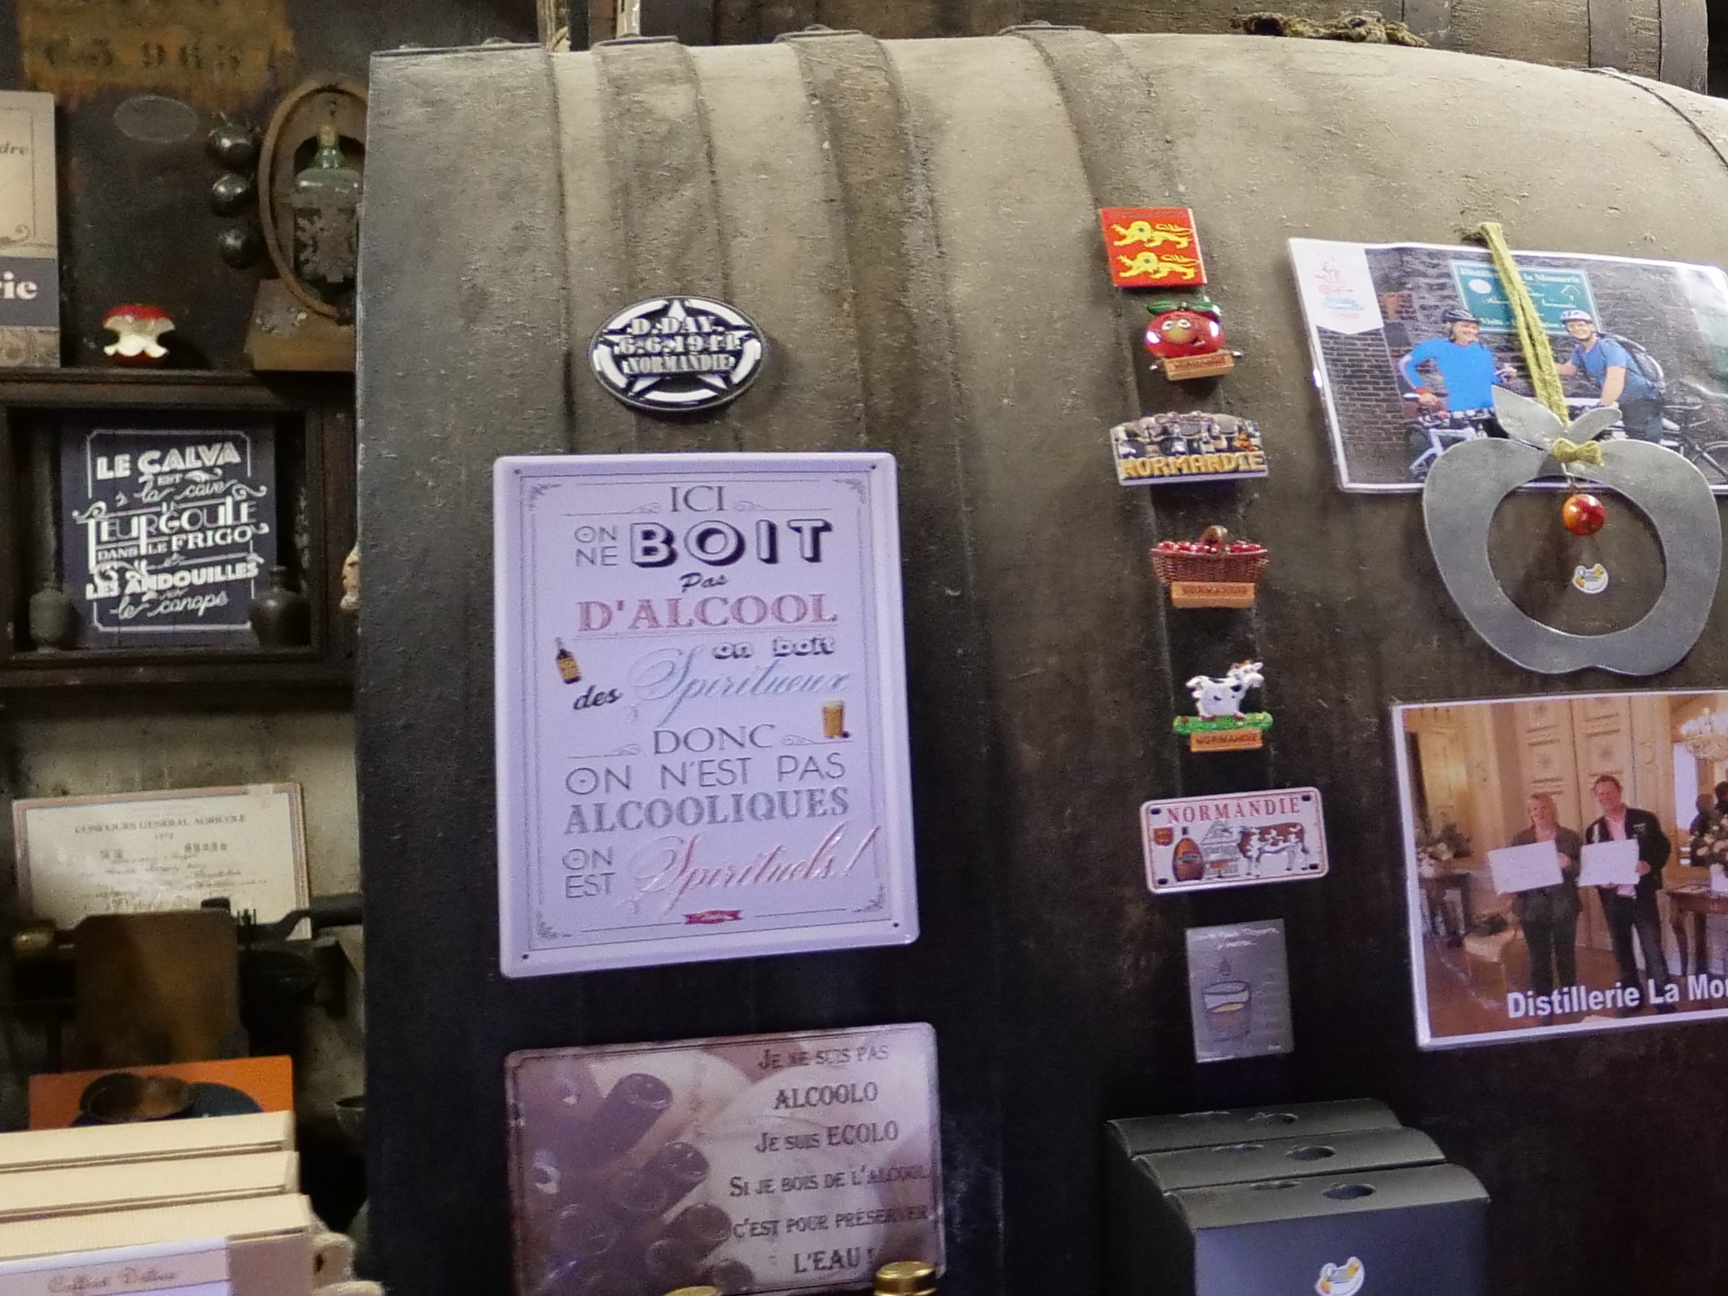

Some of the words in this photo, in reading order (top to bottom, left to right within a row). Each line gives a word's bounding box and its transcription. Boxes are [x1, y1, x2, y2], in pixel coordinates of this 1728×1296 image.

[624, 354, 735, 375] NORMANDIE
[96, 454, 131, 480] LE
[137, 441, 242, 474] CALVA
[1122, 451, 1268, 479] NORMANDIE
[157, 473, 181, 486] EST
[174, 479, 239, 501] cave
[670, 485, 727, 513] ICI
[98, 546, 138, 561] DANS
[147, 542, 169, 556] LE
[171, 526, 253, 551] FRIGO
[574, 525, 618, 544] ON
[629, 519, 833, 568] BOIT
[575, 547, 618, 567] NE
[85, 579, 120, 601] LES
[125, 560, 260, 595] ANDOUILLES
[680, 572, 730, 594] Pas
[577, 594, 838, 633] D'ALCOOL
[711, 640, 753, 660] on
[772, 634, 836, 657] boit
[572, 685, 624, 712] des
[631, 646, 853, 728] Spiritueux
[653, 723, 777, 756] DONC
[565, 765, 632, 796] ON
[660, 757, 752, 791] N'EST
[777, 752, 847, 783] PAS
[563, 786, 850, 836] ALCOOLIQUES
[1166, 796, 1301, 825] NORMANDIE
[562, 847, 615, 872] ON
[565, 873, 617, 899] EST
[1506, 981, 1641, 1019] Distillerie
[1647, 978, 1681, 1004] La
[856, 1043, 890, 1062] PAS
[773, 1081, 879, 1111] ALCOOLO
[826, 1120, 900, 1147] ECOLO
[782, 1174, 819, 1193] BOIS
[824, 1173, 846, 1190] DE
[786, 1214, 830, 1235] POUR
[793, 1250, 861, 1274] L'EAU
